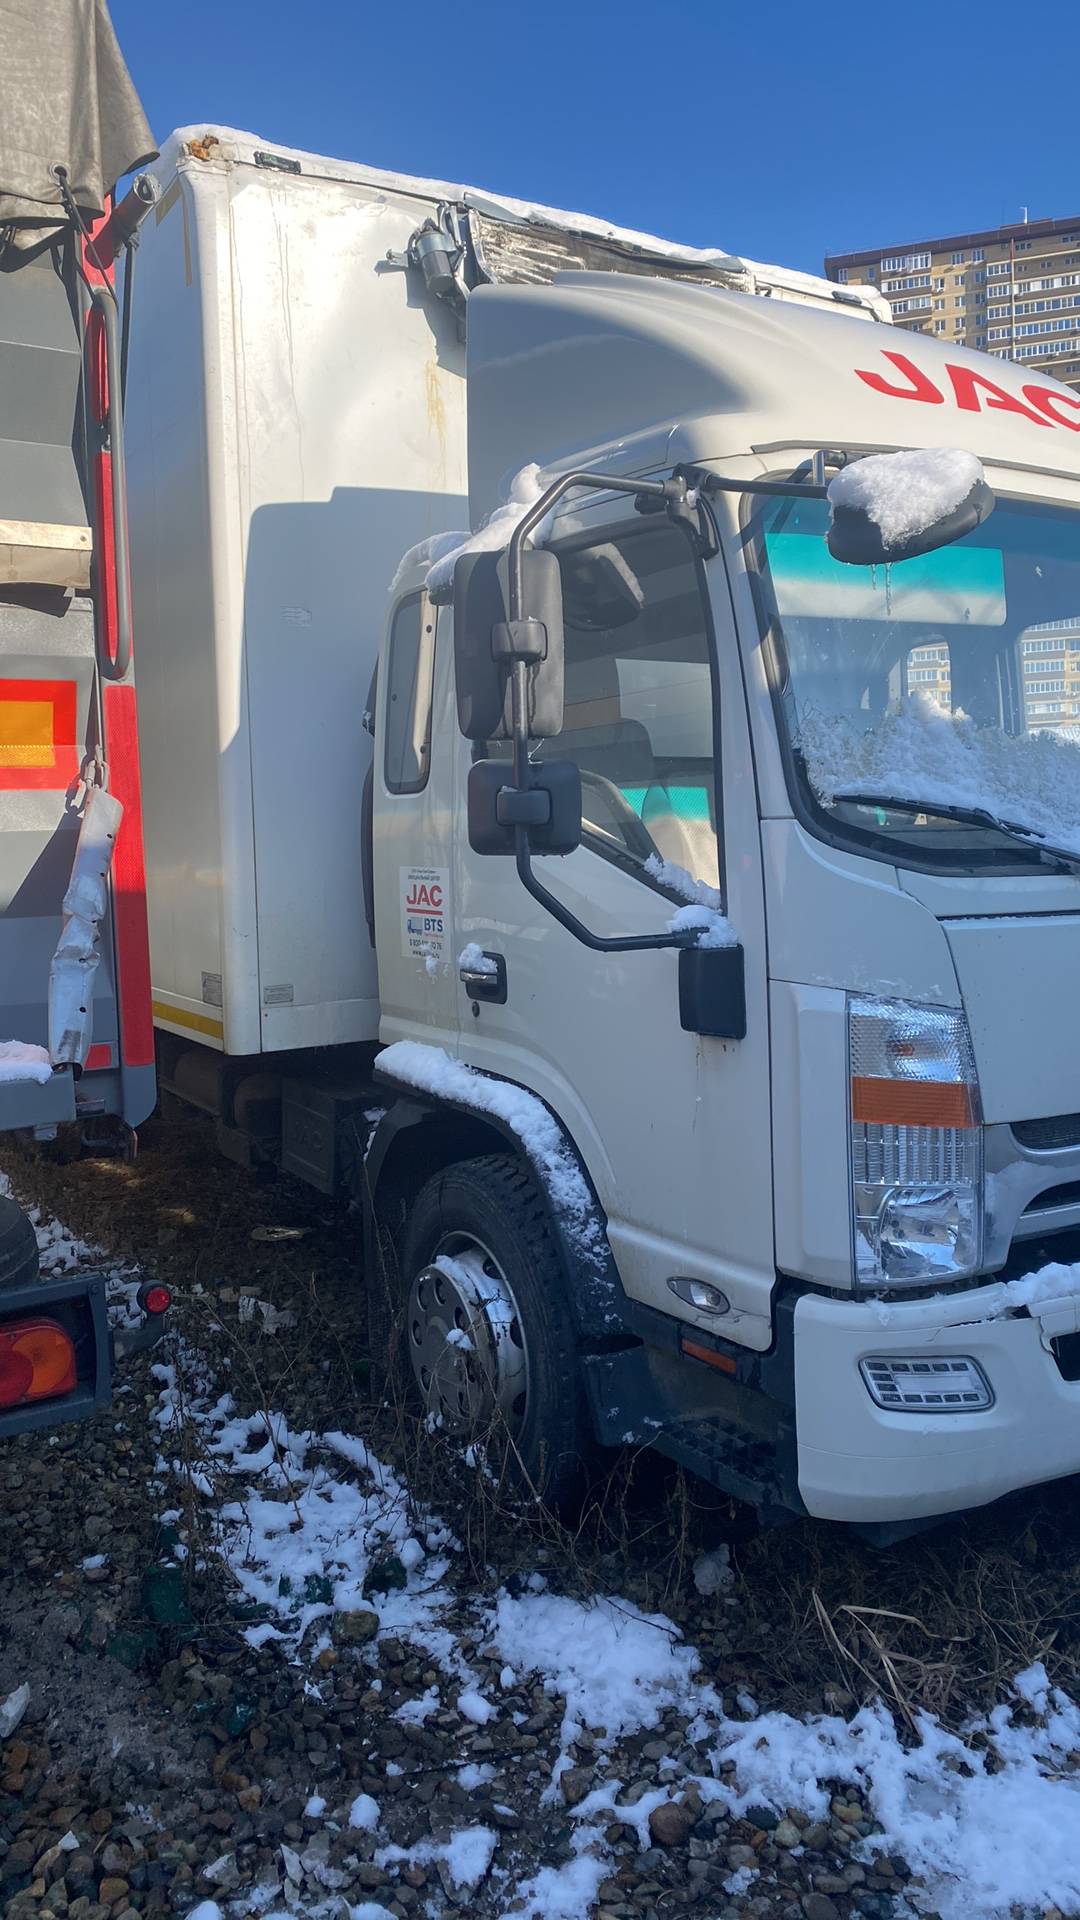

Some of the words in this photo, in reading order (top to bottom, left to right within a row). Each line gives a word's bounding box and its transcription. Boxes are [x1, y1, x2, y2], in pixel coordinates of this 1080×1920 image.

[854, 349, 1080, 432] JAC
[406, 884, 442, 907] JAC
[424, 918, 444, 932] BTS
